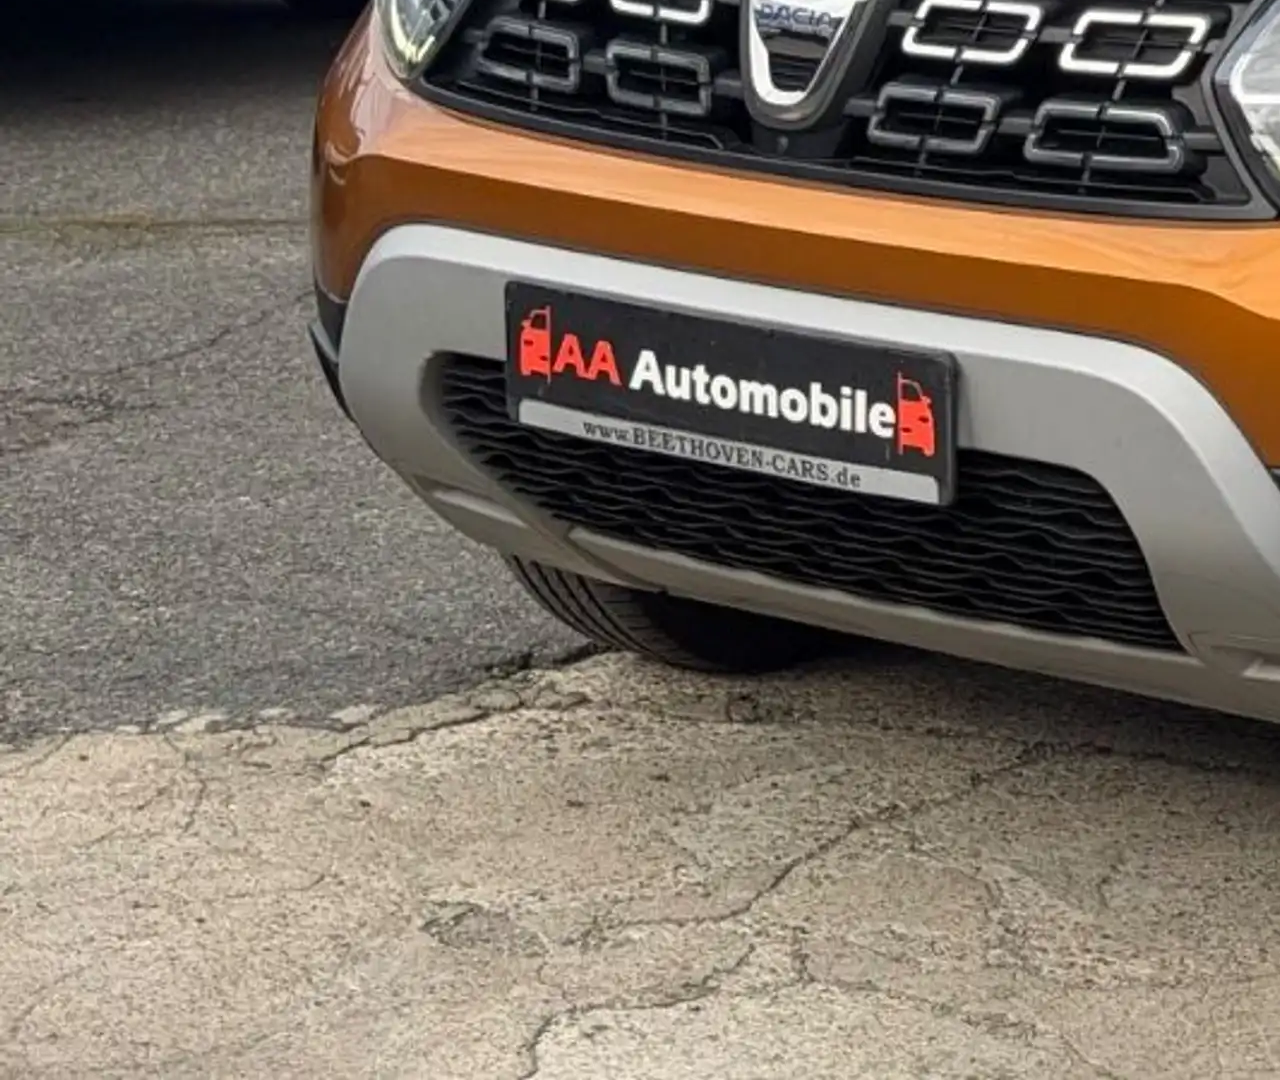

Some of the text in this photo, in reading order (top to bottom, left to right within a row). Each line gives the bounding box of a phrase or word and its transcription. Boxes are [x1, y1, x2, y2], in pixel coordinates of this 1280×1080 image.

[759, 2, 833, 28] DACIA
[553, 333, 898, 439] AA Automobile
[582, 419, 862, 490] www.BEETHOVEN-CARS.de
